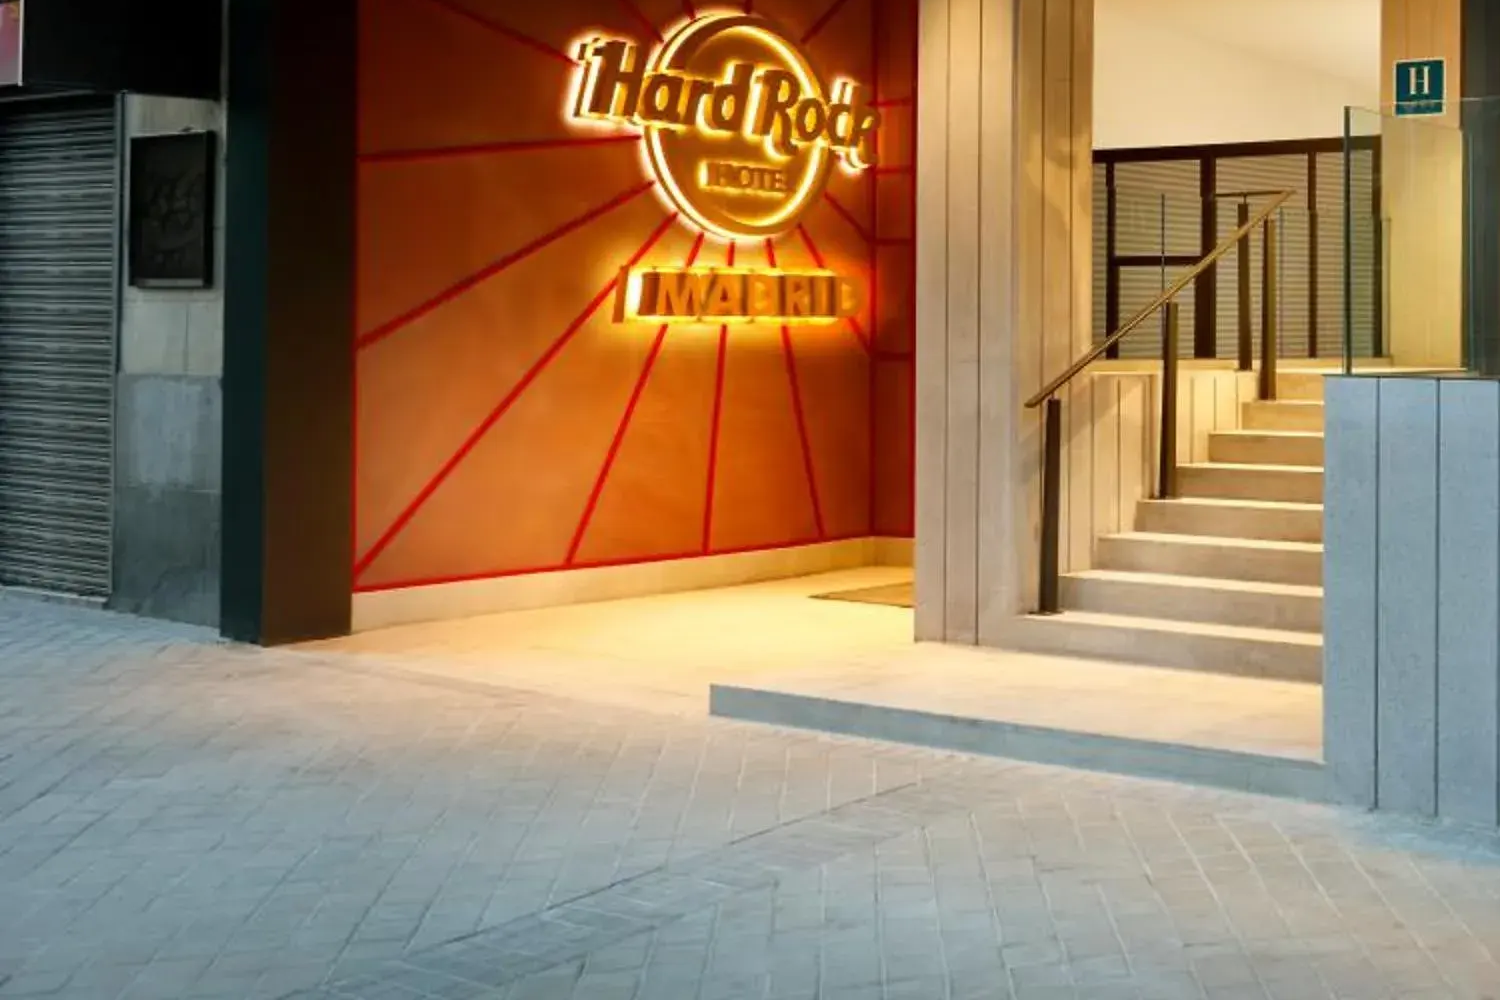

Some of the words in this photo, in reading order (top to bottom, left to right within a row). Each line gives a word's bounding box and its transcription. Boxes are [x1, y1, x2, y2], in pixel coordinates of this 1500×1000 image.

[1408, 65, 1431, 95] H
[573, 37, 756, 136] Hard
[752, 66, 882, 168] Rock
[706, 162, 788, 193] HOTEL
[638, 270, 868, 318] MADRID
